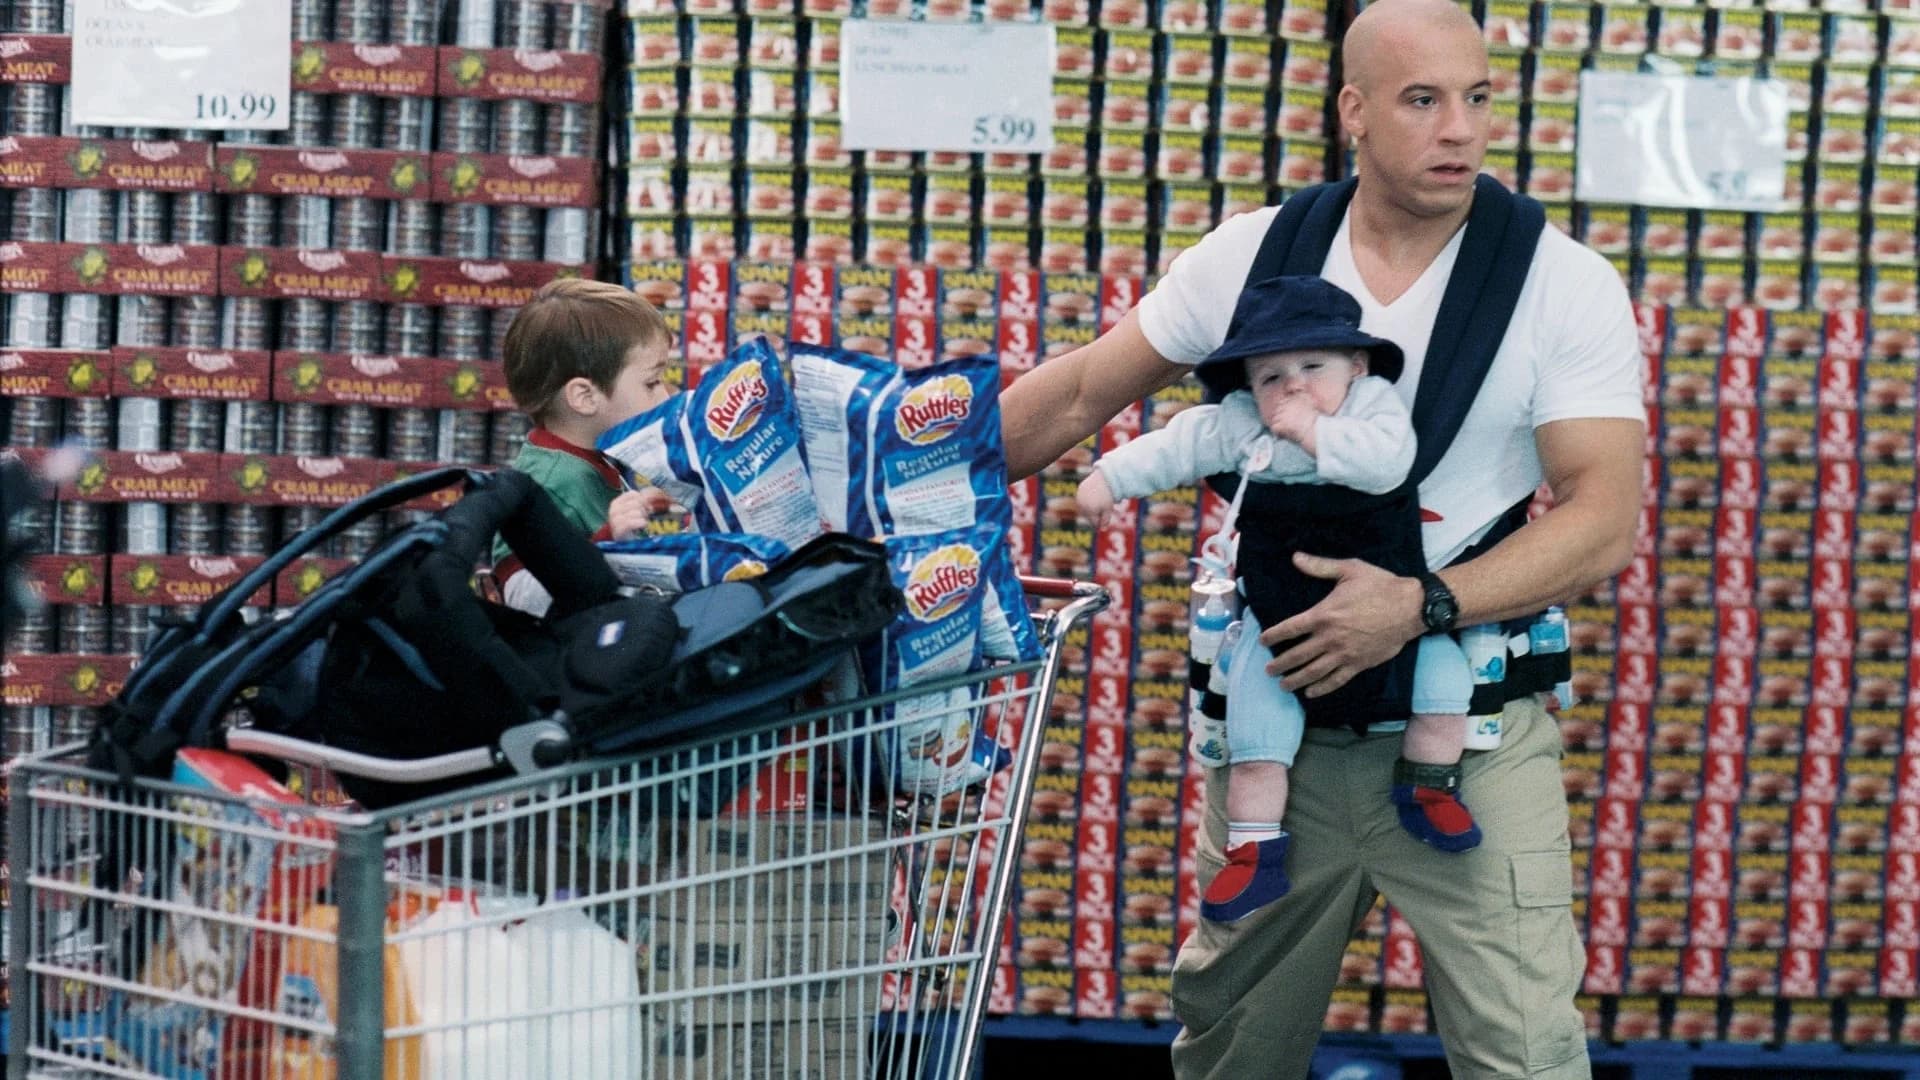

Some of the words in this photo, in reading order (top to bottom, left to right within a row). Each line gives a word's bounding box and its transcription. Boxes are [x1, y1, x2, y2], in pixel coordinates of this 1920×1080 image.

[7, 61, 57, 76] MEAT
[196, 94, 276, 120] 10.99
[972, 117, 1036, 145] 5.99
[108, 164, 155, 178] CRAB
[158, 166, 207, 181] MEAT
[2, 267, 49, 282] MEAT
[113, 269, 160, 283] CRAB
[163, 270, 211, 285] MEAT
[699, 262, 718, 292] 3
[804, 266, 824, 297] 3
[907, 269, 926, 299] 3
[1010, 272, 1030, 302] 3
[1112, 278, 1132, 306] 3
[696, 312, 716, 343] 3
[801, 318, 821, 344] 3
[906, 319, 925, 350] 3
[1009, 321, 1028, 352] 3
[1, 375, 49, 389] MEAT
[163, 374, 208, 389] CRAB
[213, 376, 260, 391] MEAT
[725, 421, 777, 473] Regular
[896, 442, 961, 472] Regular
[111, 478, 158, 492] CRAB
[161, 478, 208, 493] MEAT
[1106, 531, 1126, 561] 3
[165, 581, 212, 595] CRAB
[908, 567, 978, 611] Ruffles
[911, 611, 972, 652] Regular
[1101, 629, 1121, 660] 3
[1099, 678, 1118, 708] 3
[995, 718, 1013, 749] 3
[1096, 726, 1115, 757] 3
[1092, 775, 1111, 805] 3
[1088, 824, 1107, 854] 3
[1087, 873, 1106, 904] 3
[1085, 921, 1104, 952] 3
[1087, 971, 1107, 1001] 3
